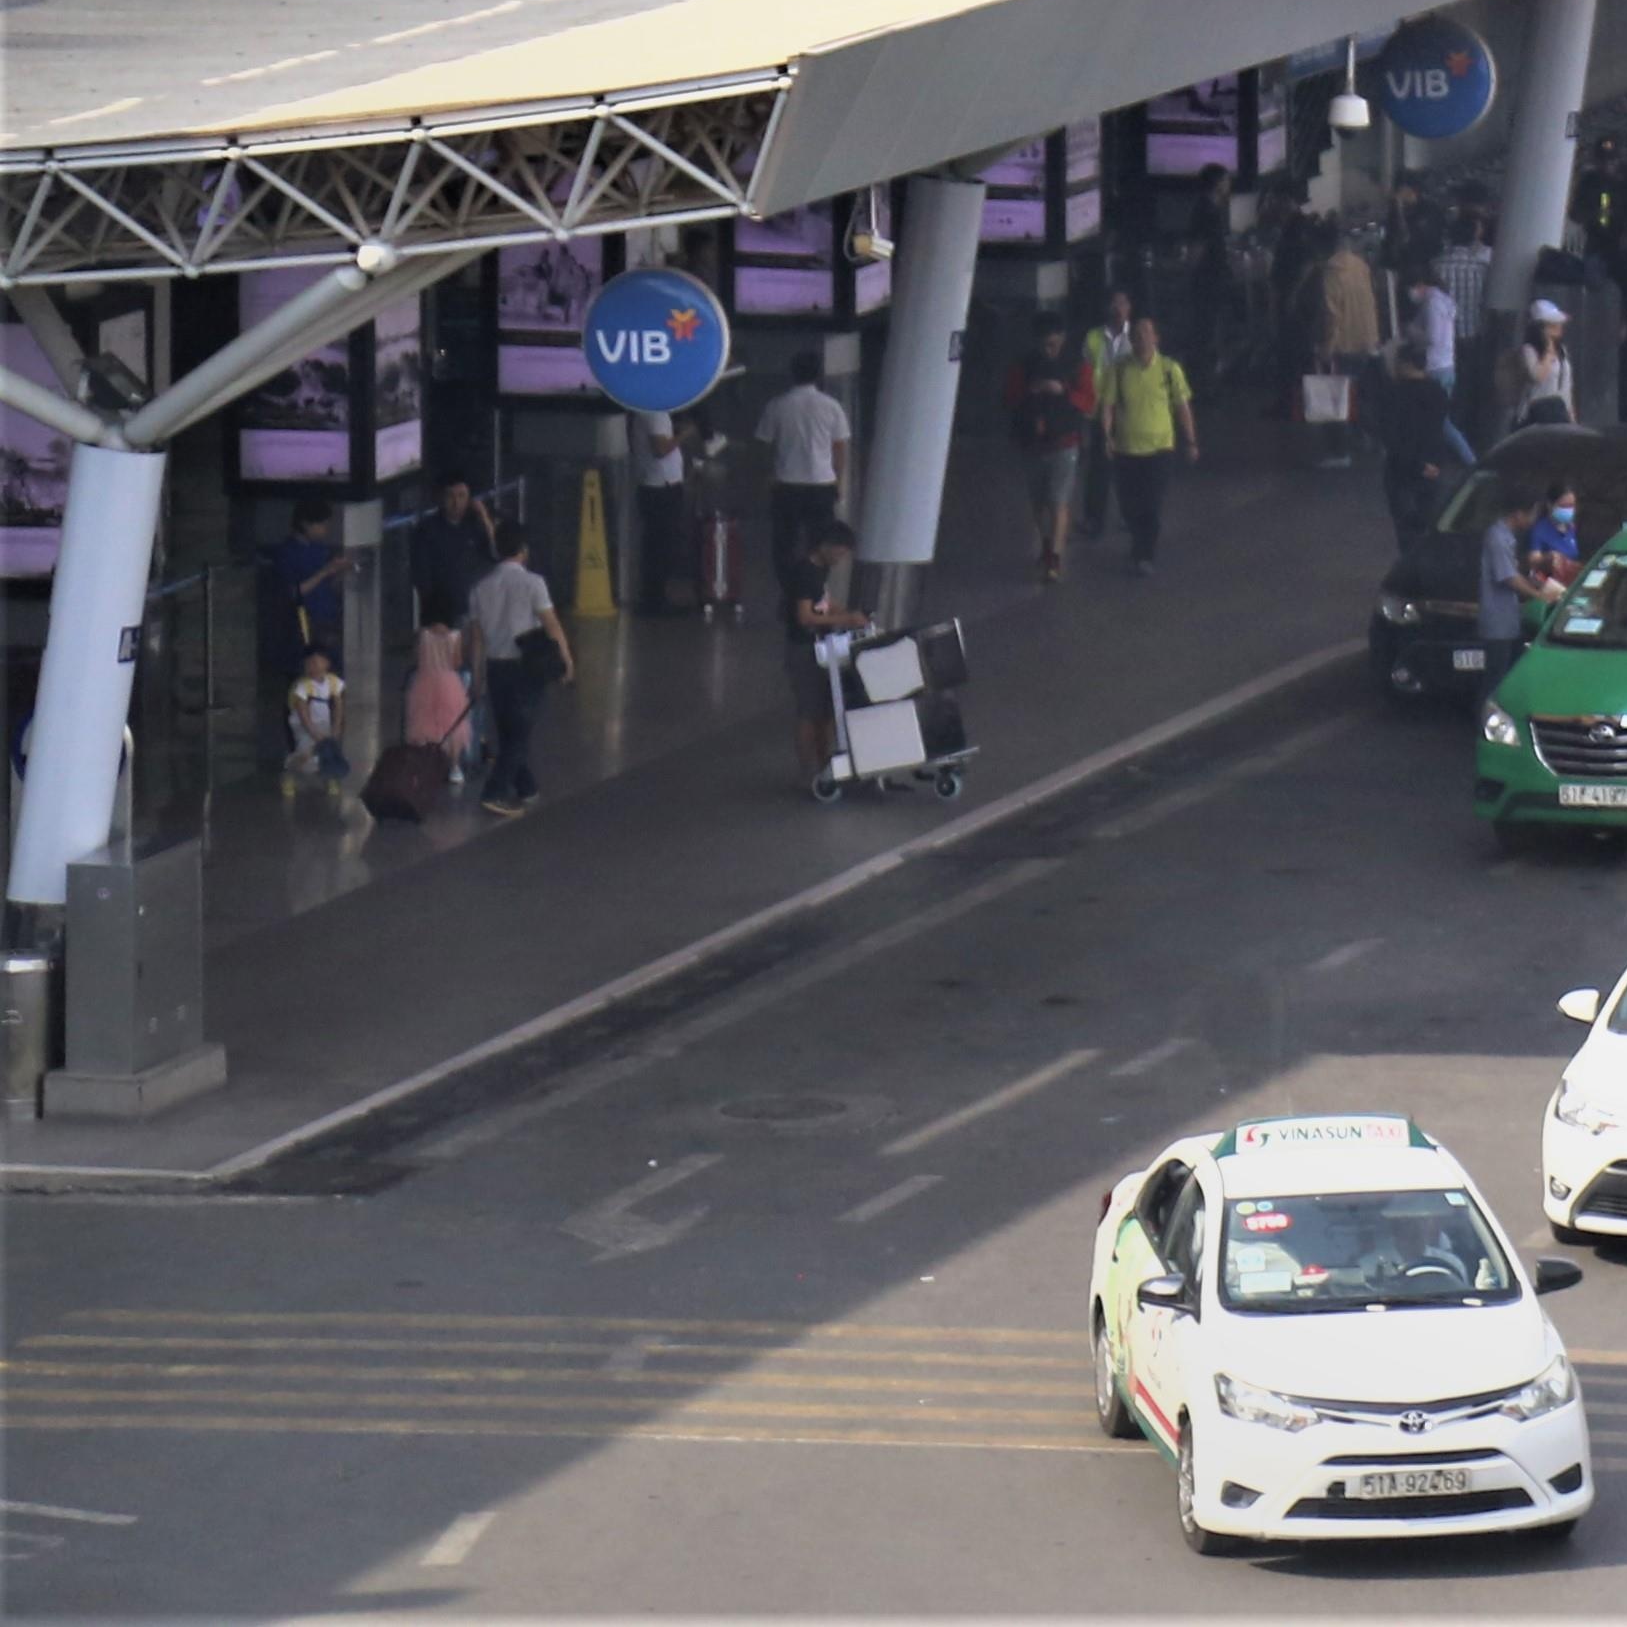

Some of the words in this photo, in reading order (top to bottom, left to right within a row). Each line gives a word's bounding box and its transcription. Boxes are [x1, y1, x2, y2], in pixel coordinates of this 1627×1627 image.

[1387, 69, 1449, 99] VIB
[596, 328, 671, 365] VIB
[1279, 1125, 1363, 1141] VINASUN
